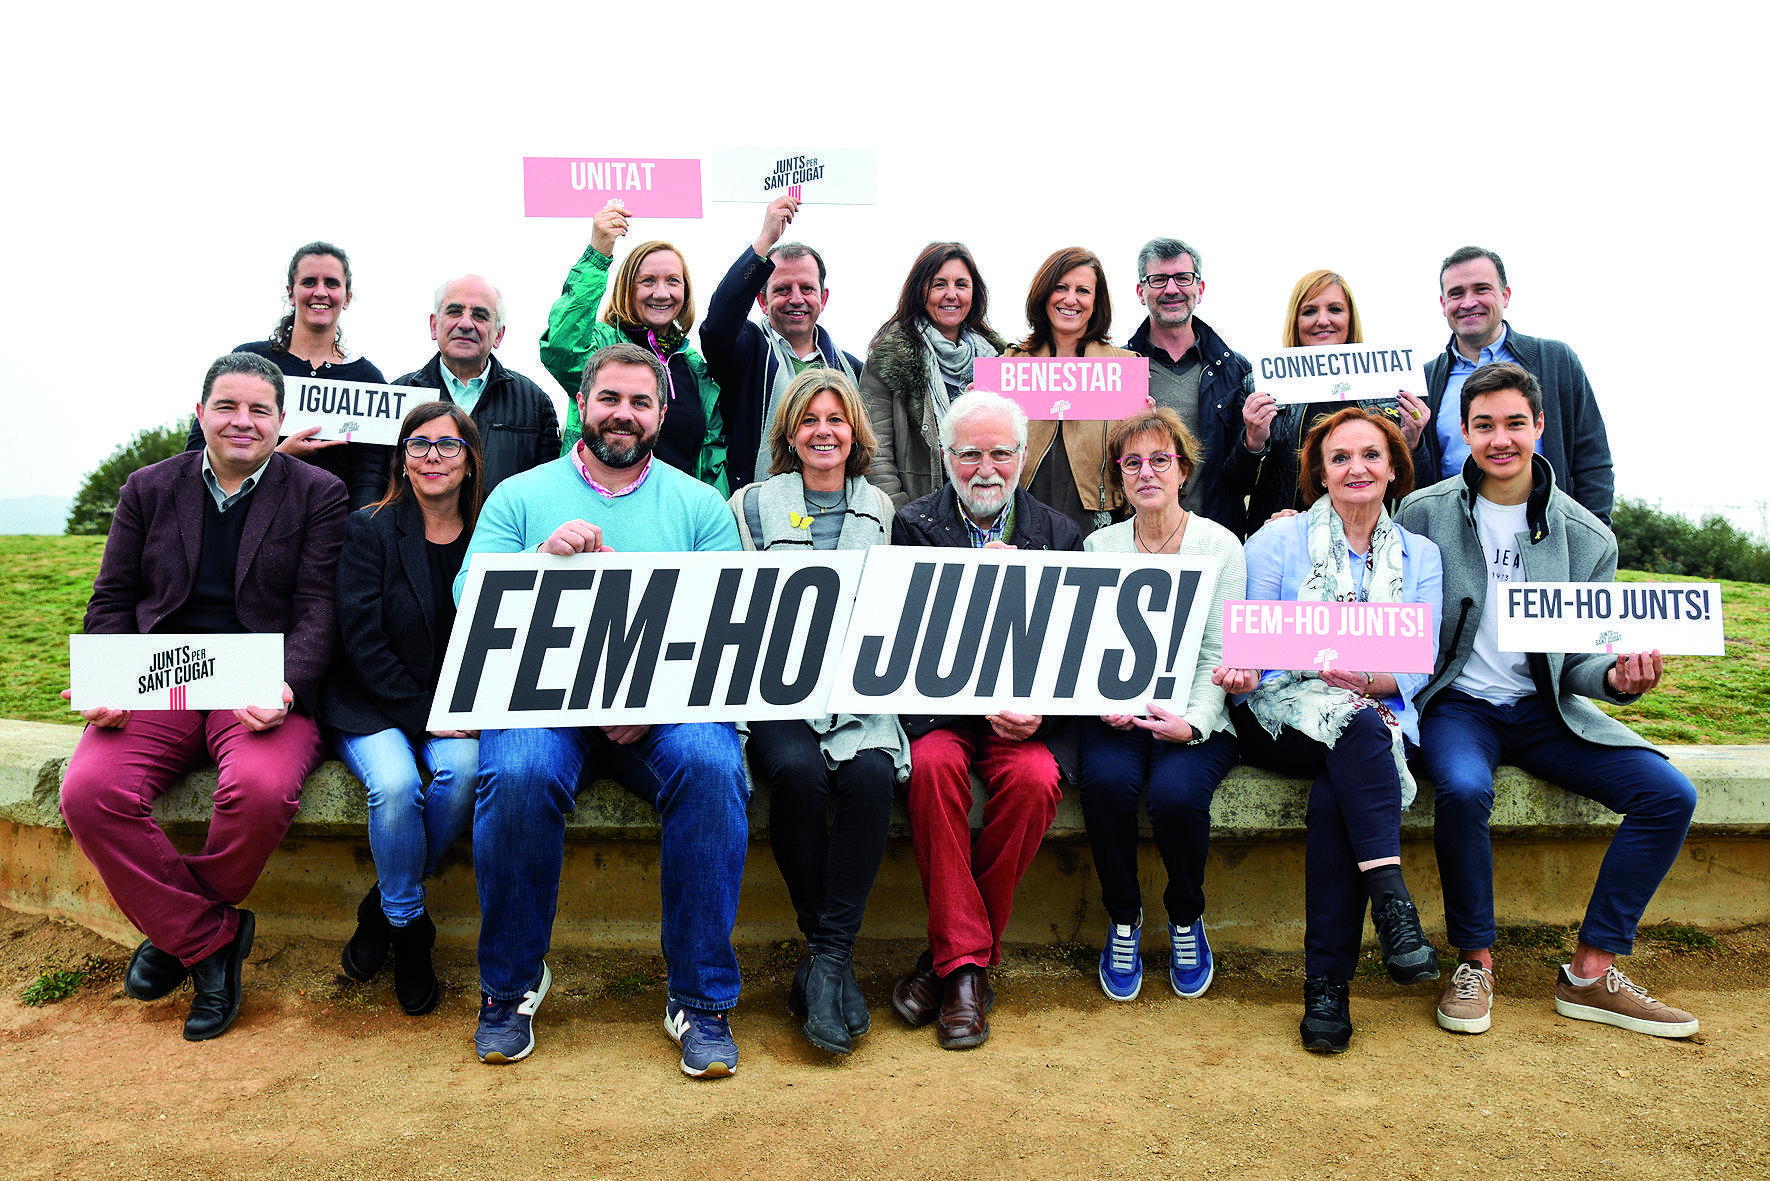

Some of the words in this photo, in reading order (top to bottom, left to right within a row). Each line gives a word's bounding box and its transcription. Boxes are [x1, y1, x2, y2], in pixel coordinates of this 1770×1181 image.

[571, 161, 655, 191] UNITAT
[764, 171, 791, 191] SANT
[792, 165, 825, 185] CUGAT
[773, 155, 805, 175] JUNTS
[806, 157, 818, 167] PER
[1001, 362, 1122, 392] BENESTAR
[1260, 349, 1413, 380] CONNECTIVITAT
[299, 384, 406, 419] IGUALTAT
[1508, 588, 1611, 619] FEM-HO
[1619, 589, 1711, 620] JUNTS!
[1230, 604, 1330, 635] FEM-HO
[1336, 606, 1424, 637] JUNTS!
[449, 565, 840, 713] FEM-HO
[853, 562, 1202, 700] JUNTS!
[149, 645, 190, 673] JUNTS
[191, 648, 206, 662] PER
[138, 668, 172, 694] SANT
[174, 658, 216, 685] CUGAT
